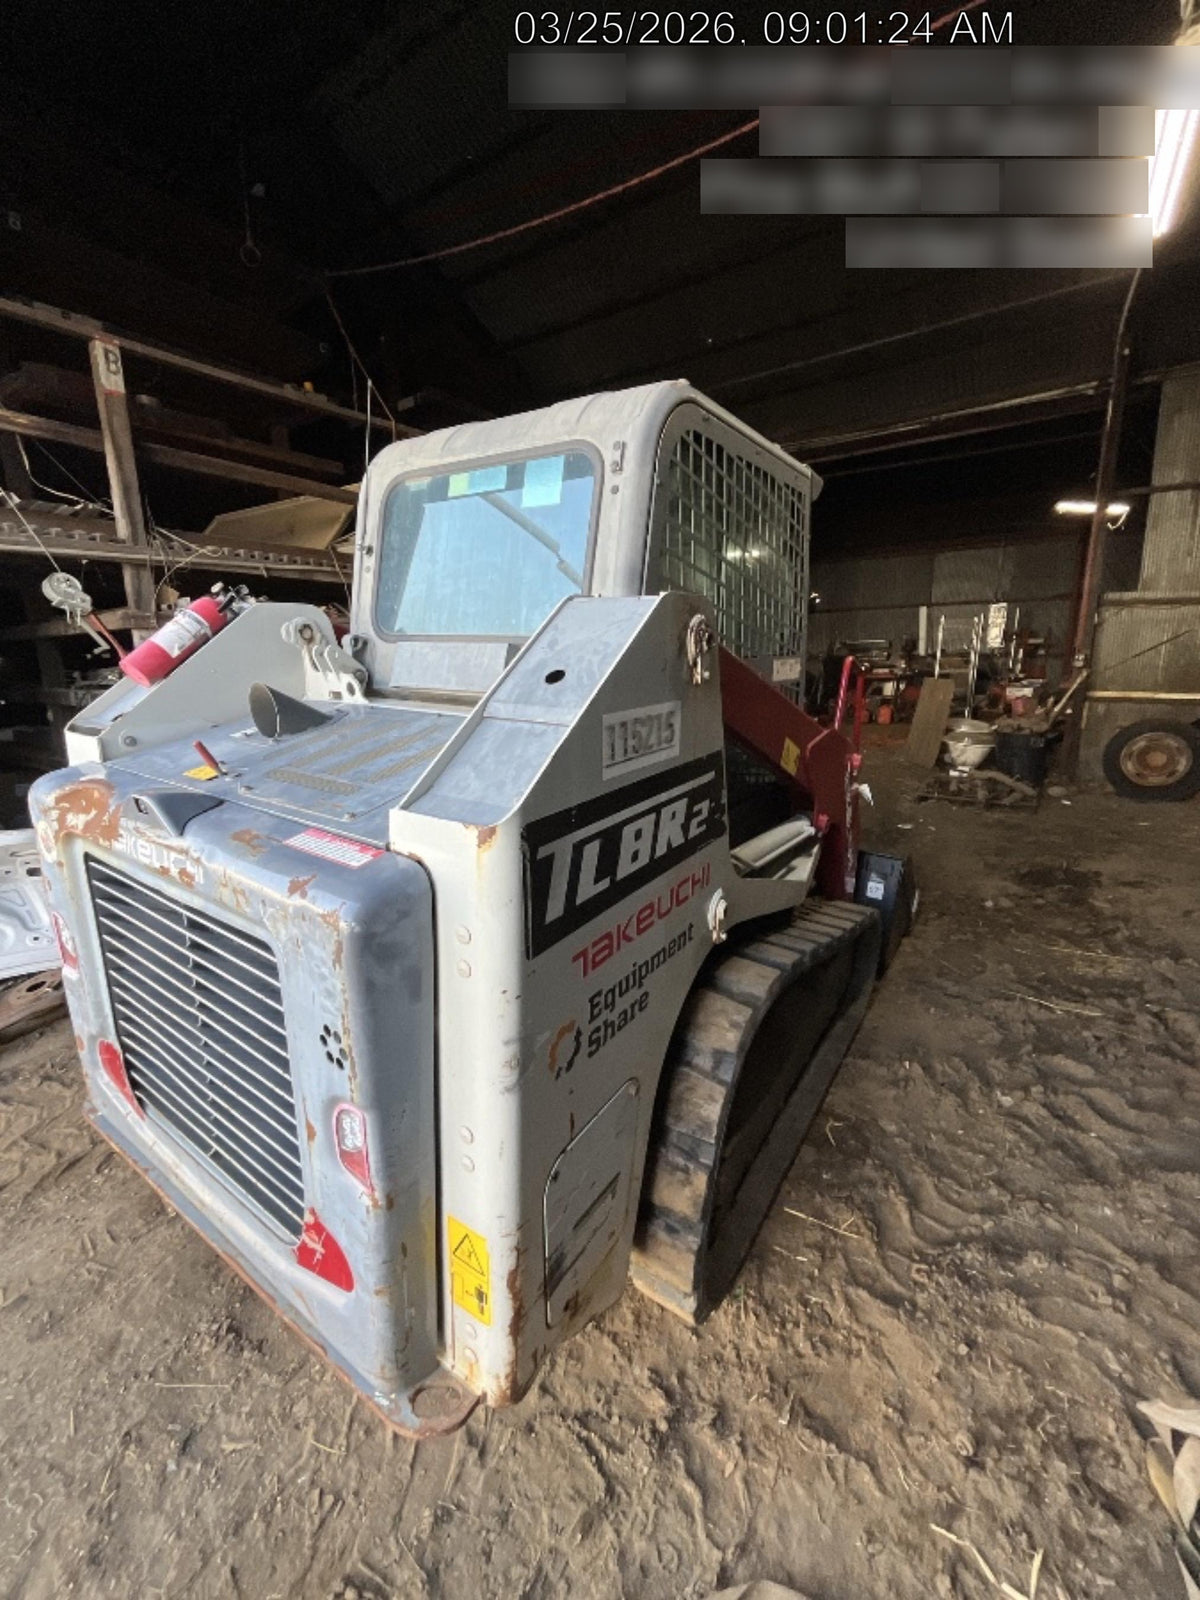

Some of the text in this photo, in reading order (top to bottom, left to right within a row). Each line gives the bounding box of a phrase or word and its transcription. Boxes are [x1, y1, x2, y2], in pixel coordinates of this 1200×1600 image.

[104, 348, 121, 375] B
[588, 922, 695, 1025] Equipment
[587, 988, 650, 1060] Share
